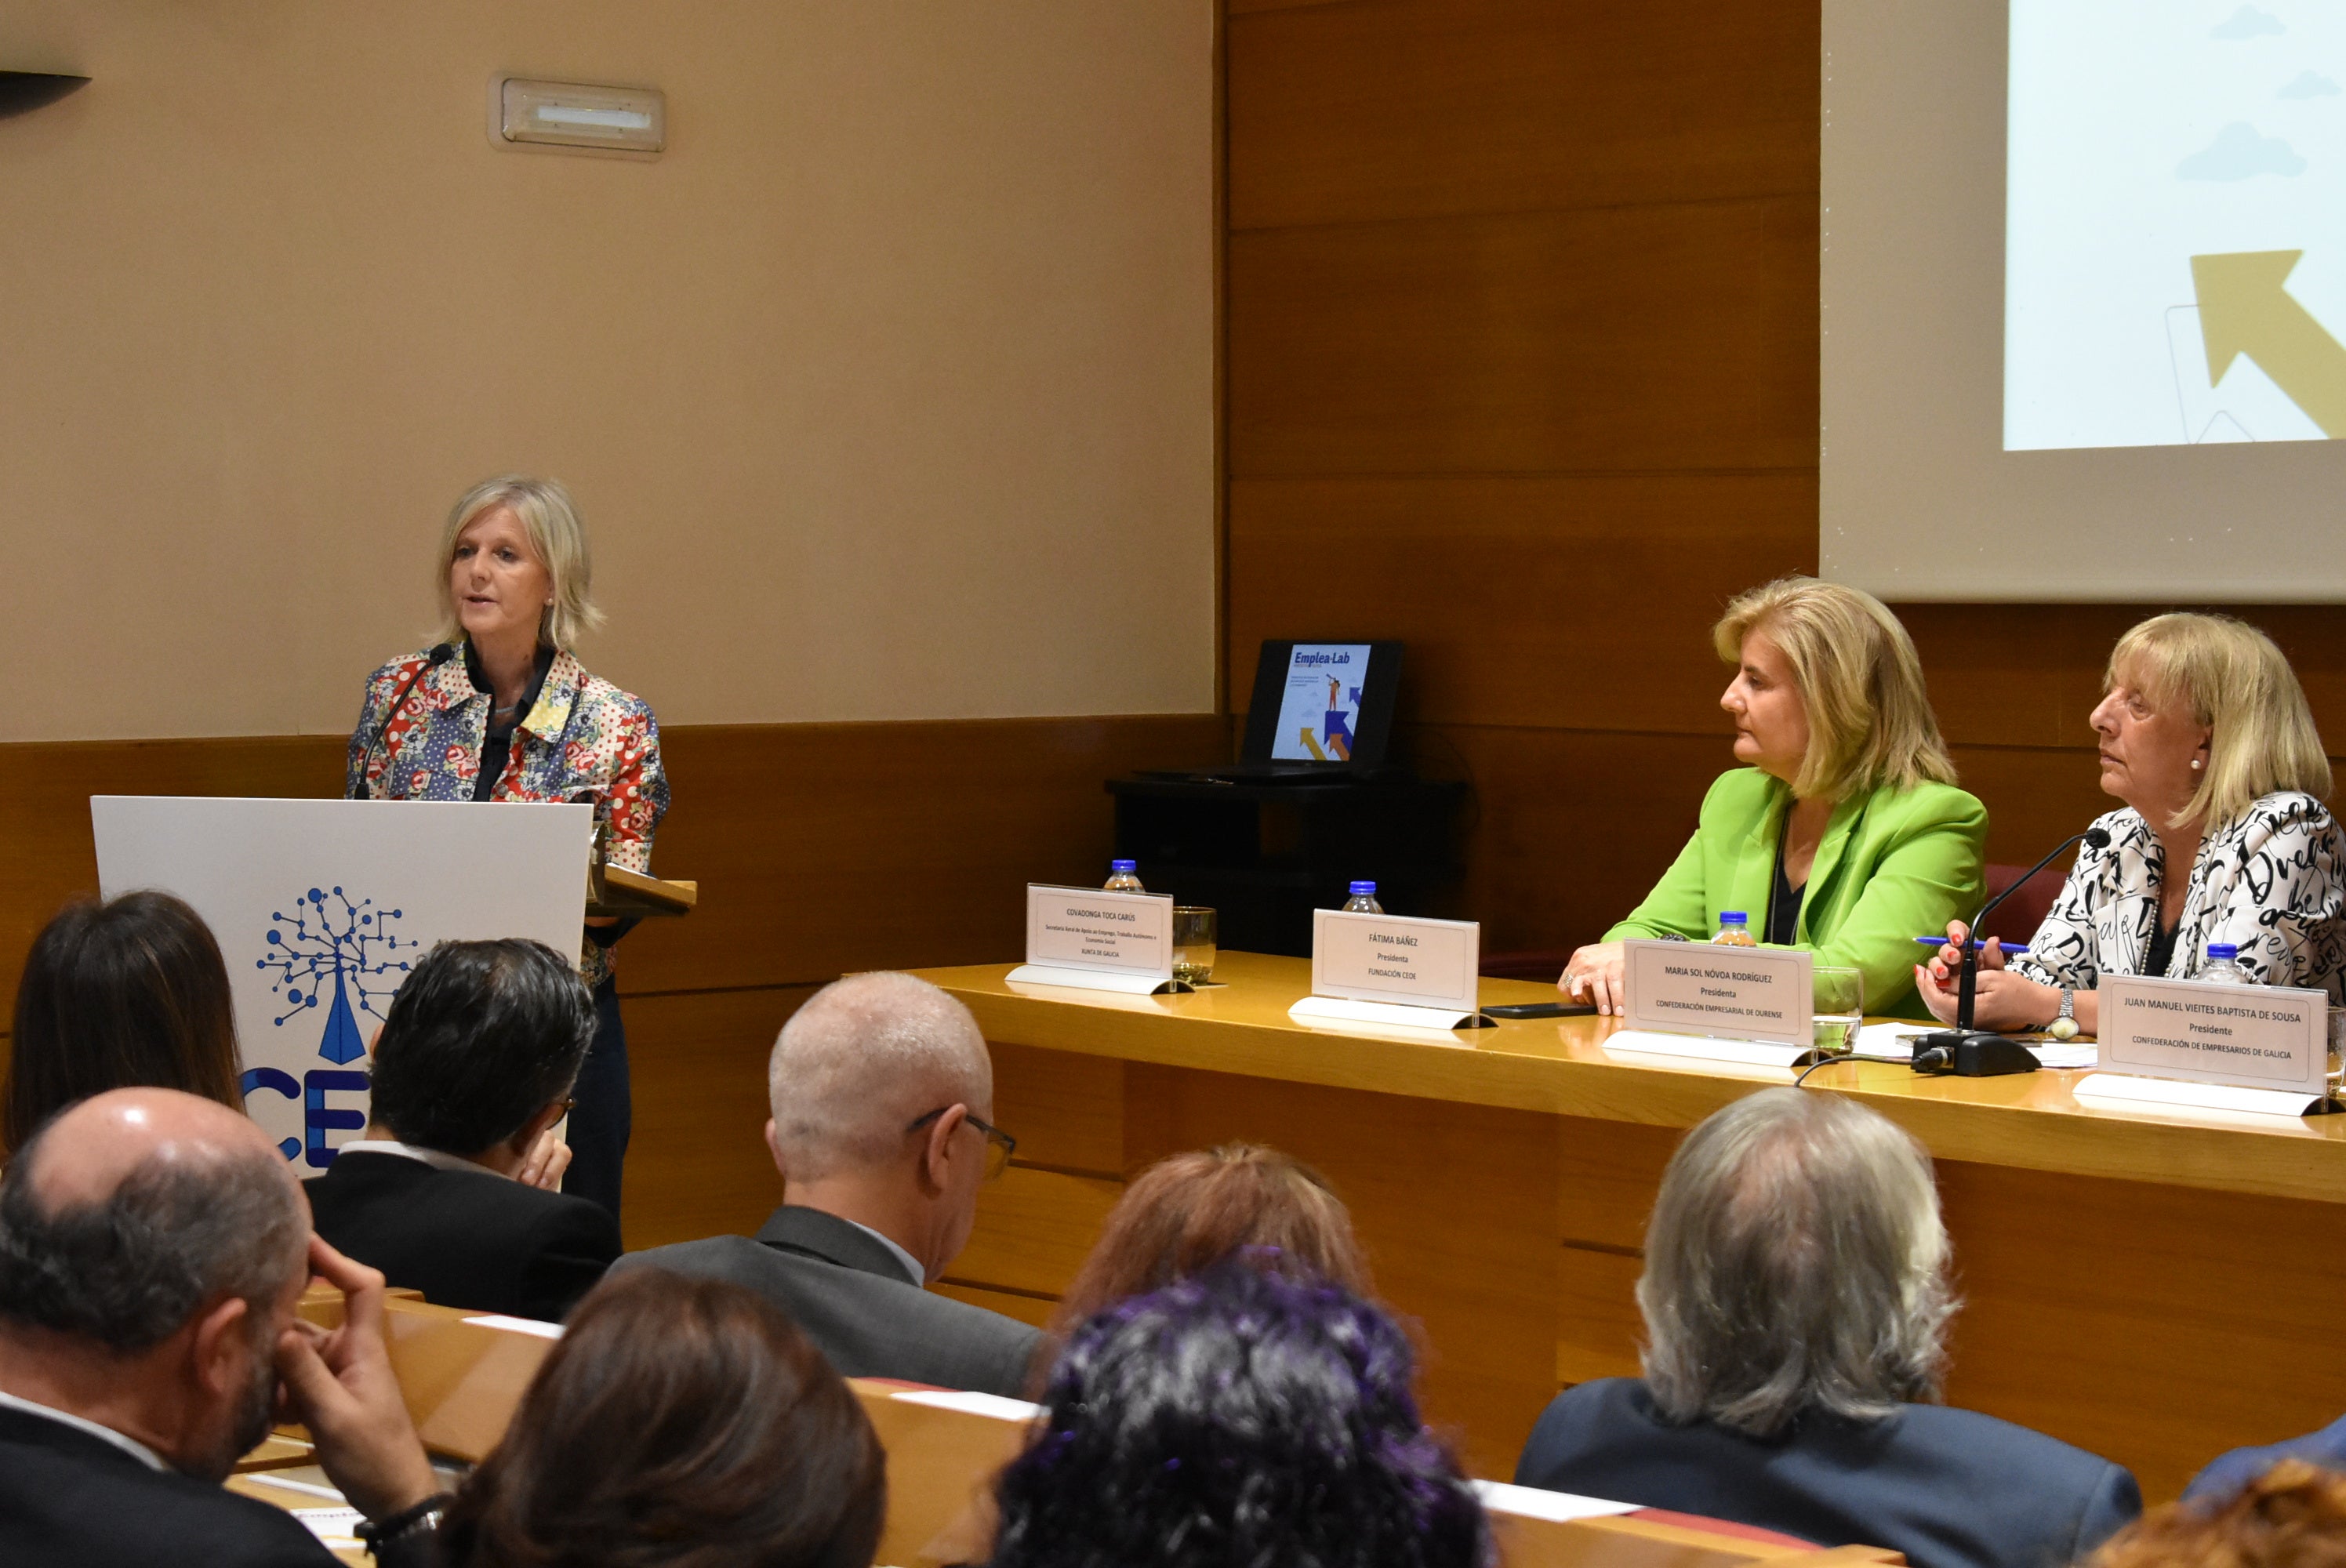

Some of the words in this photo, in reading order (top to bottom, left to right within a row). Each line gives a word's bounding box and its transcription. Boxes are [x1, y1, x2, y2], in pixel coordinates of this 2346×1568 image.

[1066, 908, 1102, 918] COVADONGA
[1117, 913, 1135, 922] CARÚS
[1368, 932, 1395, 946] FÁTIMA
[1396, 935, 1418, 946] BÁÑEZ
[1377, 953, 1408, 964] Presidenta
[1368, 968, 1401, 979] FUNDACIÓN
[1402, 971, 1417, 980] CEOE
[1665, 966, 1689, 976] MARIA
[1690, 968, 1704, 978] SOL
[1705, 968, 1730, 980] NÓVOA
[1731, 971, 1773, 984] RODRÍGUEZ
[1700, 987, 1737, 998] Presidenta
[1656, 1000, 1705, 1011] CONFEDERACIÓN
[1705, 1004, 1745, 1015] EMPRESARIAL
[1745, 1008, 1754, 1017] DE
[1755, 1008, 1783, 1019] OURENSE
[2124, 997, 2146, 1007] JUAN
[2148, 1000, 2184, 1011] MANUEL
[2184, 1004, 2215, 1014] VIEITES
[2217, 1007, 2257, 1018] BAPTISTA
[2258, 1010, 2271, 1020] DE
[2272, 1011, 2301, 1023] SOUSA
[2189, 1022, 2233, 1036] Presidente
[2132, 1035, 2190, 1049] CONFEDERACIÓN
[2192, 1041, 2201, 1050] DE
[2202, 1042, 2251, 1055] EMPRESARIOS
[2252, 1047, 2262, 1057] DE
[2264, 1049, 2292, 1060] GALICIA
